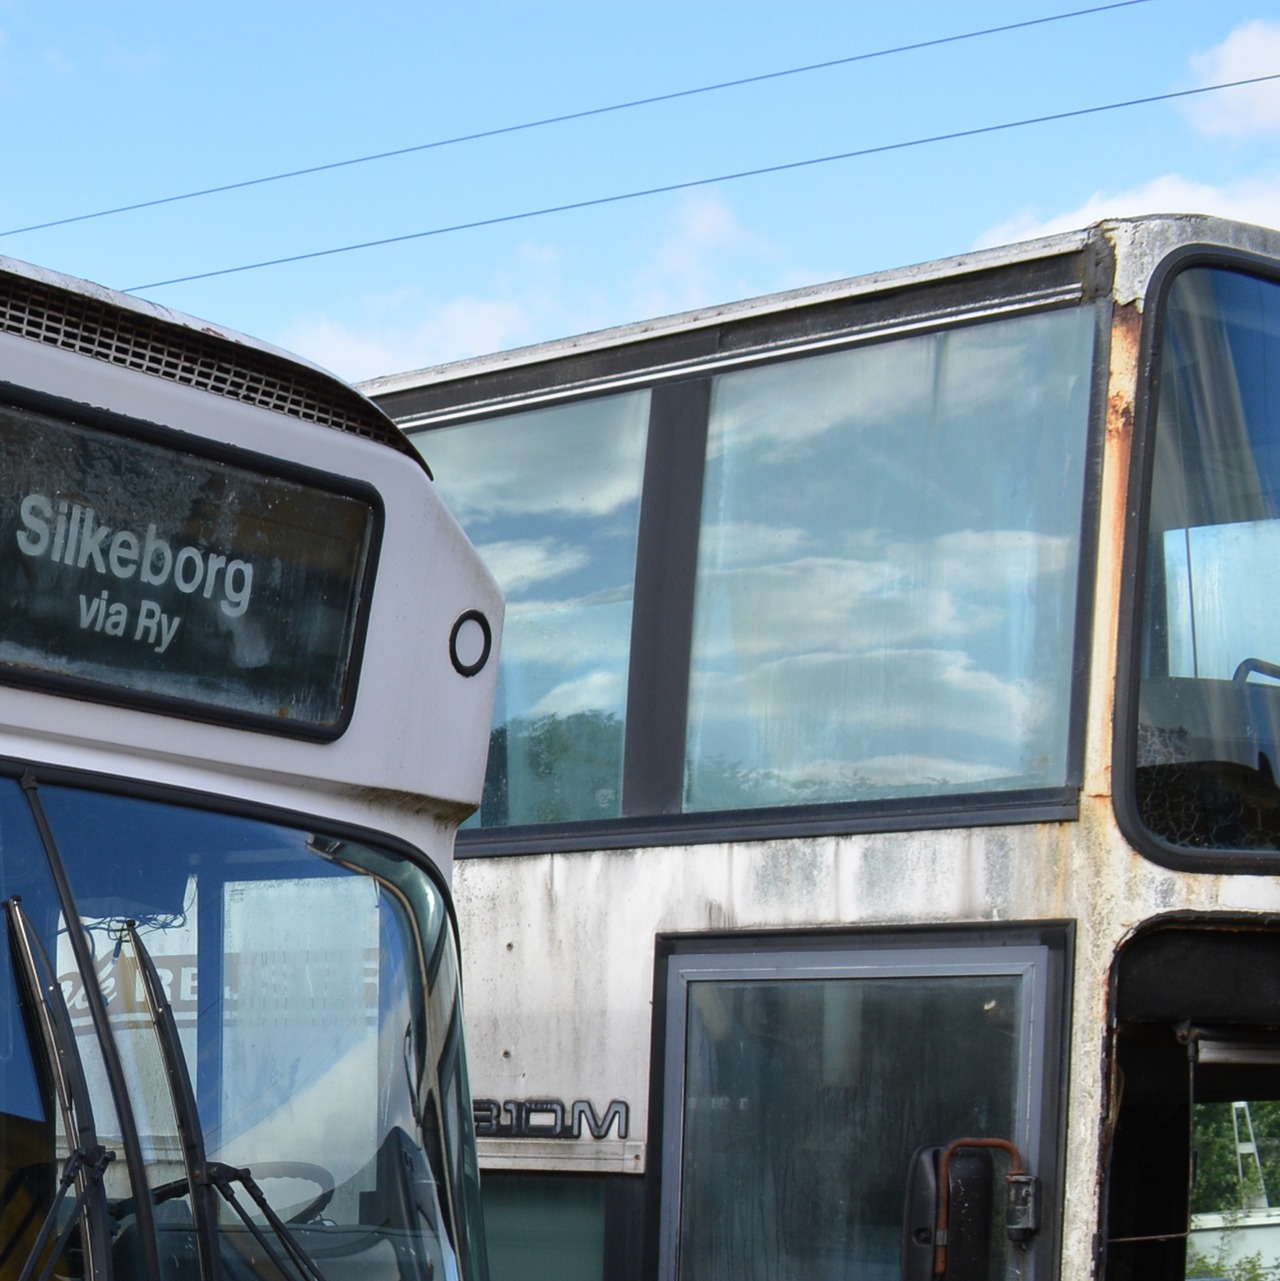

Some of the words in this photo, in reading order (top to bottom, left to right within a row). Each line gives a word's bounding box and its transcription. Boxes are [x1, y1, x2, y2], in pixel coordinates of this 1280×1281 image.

[16, 494, 253, 617] Silkeborg
[79, 590, 128, 637] via
[134, 600, 181, 653] Ry
